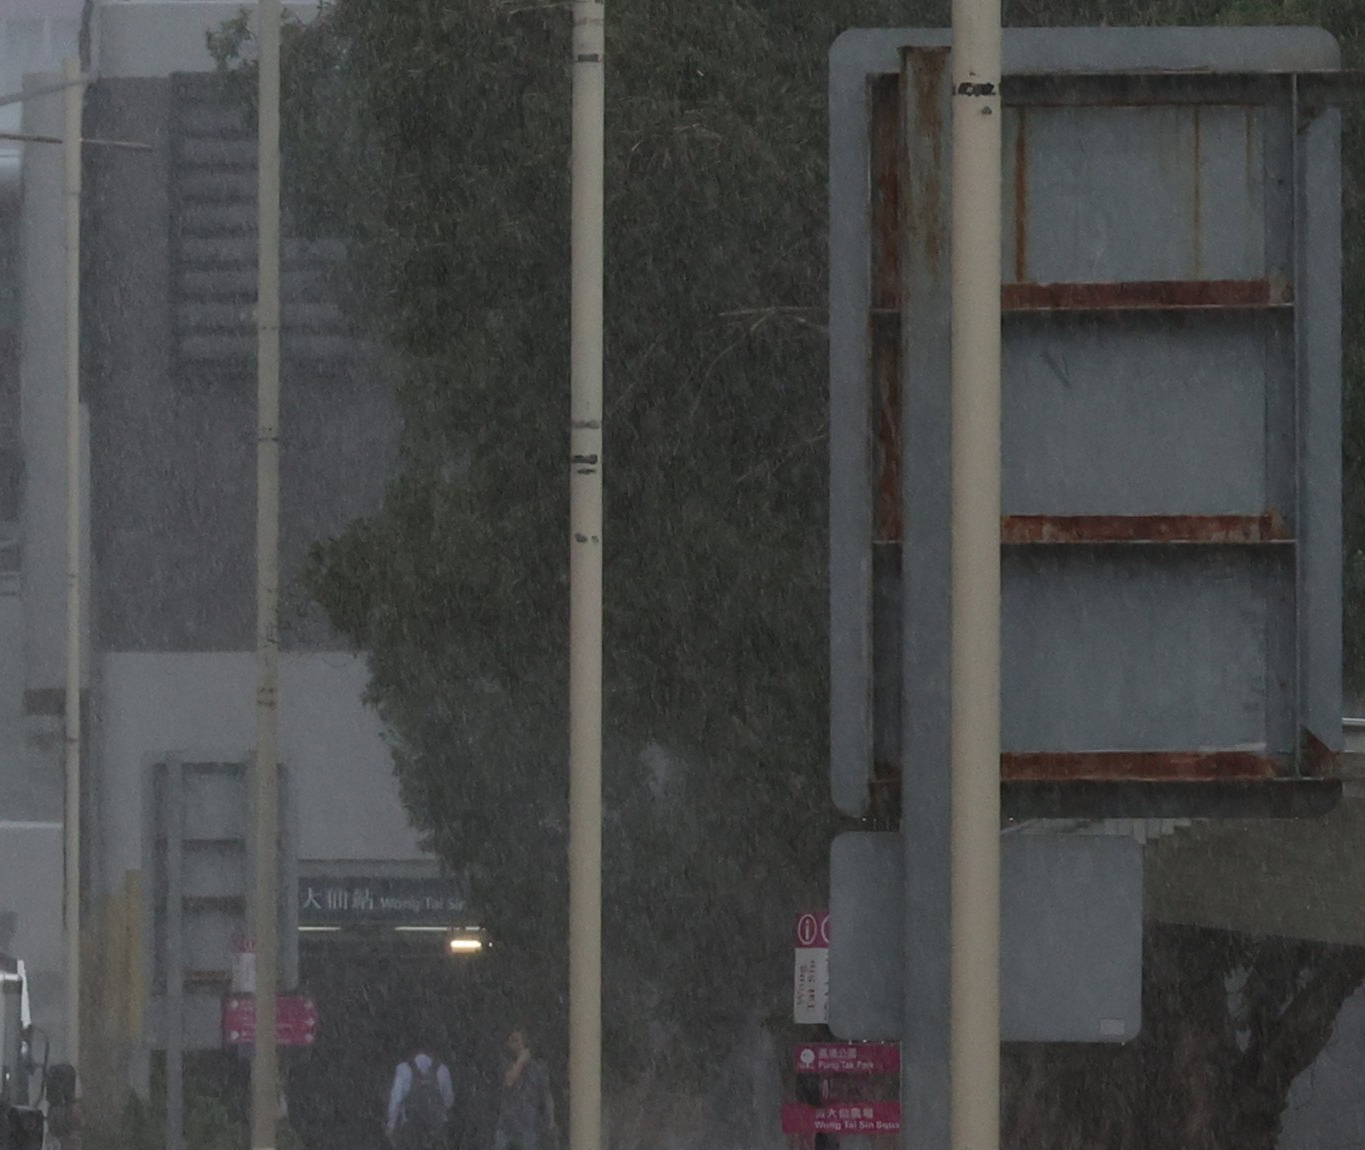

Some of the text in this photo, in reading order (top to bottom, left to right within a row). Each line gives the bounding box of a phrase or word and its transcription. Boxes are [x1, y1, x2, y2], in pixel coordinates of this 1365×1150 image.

[380, 897, 420, 912] Wong
[425, 896, 444, 910] Tai
[814, 1120, 842, 1130] Wong
[844, 1120, 857, 1129] Tai
[859, 1120, 874, 1129] Sin
